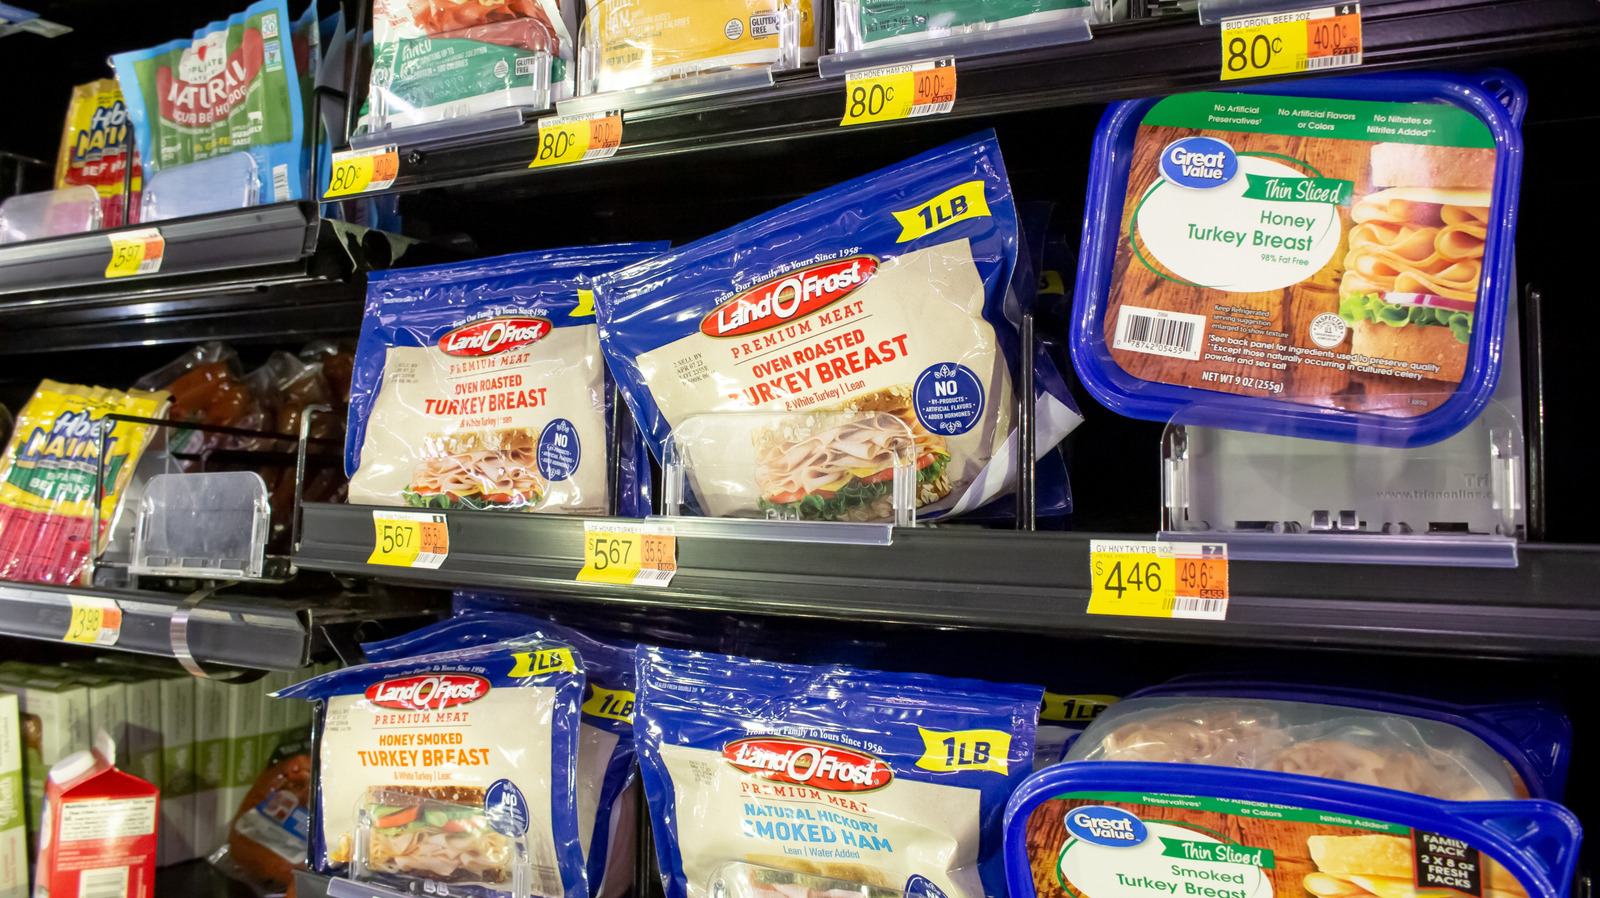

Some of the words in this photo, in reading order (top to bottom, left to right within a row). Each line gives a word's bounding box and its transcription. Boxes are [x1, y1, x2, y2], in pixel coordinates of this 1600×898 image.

[752, 17, 776, 26] GLUTEN
[1226, 22, 1241, 30] BUD
[1244, 18, 1270, 28] ORGNL
[1273, 15, 1293, 24] BEEF
[1295, 12, 1310, 21] 2OZ
[752, 26, 767, 35] FREE
[850, 72, 863, 80] BUD
[864, 68, 884, 78] HONEY
[886, 66, 900, 74] HAM
[1214, 104, 1225, 112] No
[1227, 105, 1260, 114] Artificial
[1278, 108, 1290, 116] No
[1291, 109, 1325, 118] Artificial
[1326, 111, 1356, 120] Flavors
[565, 114, 585, 124] TURKEY
[1308, 121, 1335, 131] Colors
[1373, 114, 1386, 122] No
[1388, 115, 1421, 125] Nitrates
[1366, 126, 1396, 135] Nitrites
[1171, 147, 1226, 169] Great
[1182, 164, 1223, 180] Value
[1265, 179, 1292, 200] Thin
[1296, 180, 1343, 204] Sliced
[918, 195, 969, 230] 1LB
[1260, 210, 1316, 232] Honey
[1188, 223, 1248, 248] Turkey
[1252, 230, 1313, 252] Breast
[1261, 254, 1277, 263] 98%
[1278, 255, 1291, 264] Fat
[1292, 257, 1309, 266] Free
[714, 291, 734, 306] From
[735, 282, 751, 294] Our
[752, 270, 778, 286] Family
[778, 264, 790, 274] To
[790, 258, 814, 270] Yours
[815, 252, 837, 263] Since
[838, 246, 860, 258] 1958
[731, 321, 812, 359] PREMIUM
[818, 300, 865, 327] MEAT
[752, 355, 793, 378] OVEN
[793, 329, 866, 365] ROASTED
[815, 333, 909, 384] BREAST
[1204, 353, 1236, 363] powder
[1237, 357, 1254, 366] and
[1255, 361, 1271, 369] sea
[1271, 362, 1287, 371] salt
[1227, 336, 1249, 346] back
[1249, 340, 1275, 350] panel
[1275, 343, 1287, 352] for
[1288, 345, 1335, 359] ingredients
[1336, 352, 1358, 362] used
[1359, 355, 1368, 363] to
[1369, 356, 1408, 369] preserve
[1410, 362, 1440, 374] quality
[449, 357, 496, 375] PREMIUM
[500, 353, 531, 367] MEAT
[1243, 348, 1265, 358] those
[1267, 351, 1304, 364] naturally
[1304, 358, 1346, 371] occurring
[1346, 362, 1355, 371] in
[1357, 364, 1393, 376] cultured
[1394, 369, 1424, 382] celery
[455, 381, 479, 396] OVEN
[480, 374, 523, 392] ROASTED
[934, 380, 958, 397] NO
[1202, 371, 1219, 382] NET
[1220, 373, 1235, 384] WT
[1235, 376, 1241, 385] 9
[1242, 377, 1254, 388] OZ
[1254, 379, 1284, 394] (255g)
[425, 395, 486, 416] TURKEY
[488, 387, 547, 413] BREAST
[792, 393, 815, 410] White
[815, 386, 841, 404] Turkey
[845, 379, 866, 393] Lean
[931, 396, 964, 405] BY-PRODUCTS
[926, 405, 950, 413] ARTIFICIAL
[951, 403, 972, 411] FLAVORS
[944, 411, 971, 419] HORMONES
[554, 433, 568, 448] NO
[1096, 545, 1107, 553] GV
[1109, 545, 1125, 553] HNY
[1125, 545, 1140, 553] TKY
[1141, 546, 1157, 554] TUB
[374, 713, 431, 725] PREMIUM
[436, 712, 469, 723] MEAT
[379, 734, 415, 746] HONEY
[417, 732, 463, 746] SMOKED
[357, 750, 418, 767] TURKEY
[422, 748, 490, 767] BREAST
[741, 781, 822, 801] PREMIUM
[827, 794, 868, 814] MEAT
[744, 803, 816, 821] NATURAL
[817, 810, 879, 834] HICKORY
[1074, 813, 1134, 832] Great
[841, 829, 893, 853] HAM
[1089, 827, 1135, 841] Value
[1423, 834, 1469, 850] FAMILY
[783, 845, 802, 856] Lean
[809, 847, 834, 858] Water
[834, 849, 860, 859] Added
[1181, 842, 1213, 861] Thin
[1215, 845, 1263, 868] Sliced
[1428, 843, 1466, 858] PACK
[1421, 854, 1430, 864] 2
[1446, 858, 1455, 868] 8
[1171, 864, 1245, 885] Smoked
[1428, 864, 1469, 879] FRESH
[1115, 873, 1178, 895] Turkey
[1184, 881, 1247, 898] Breast
[1427, 873, 1472, 889] PACKS
